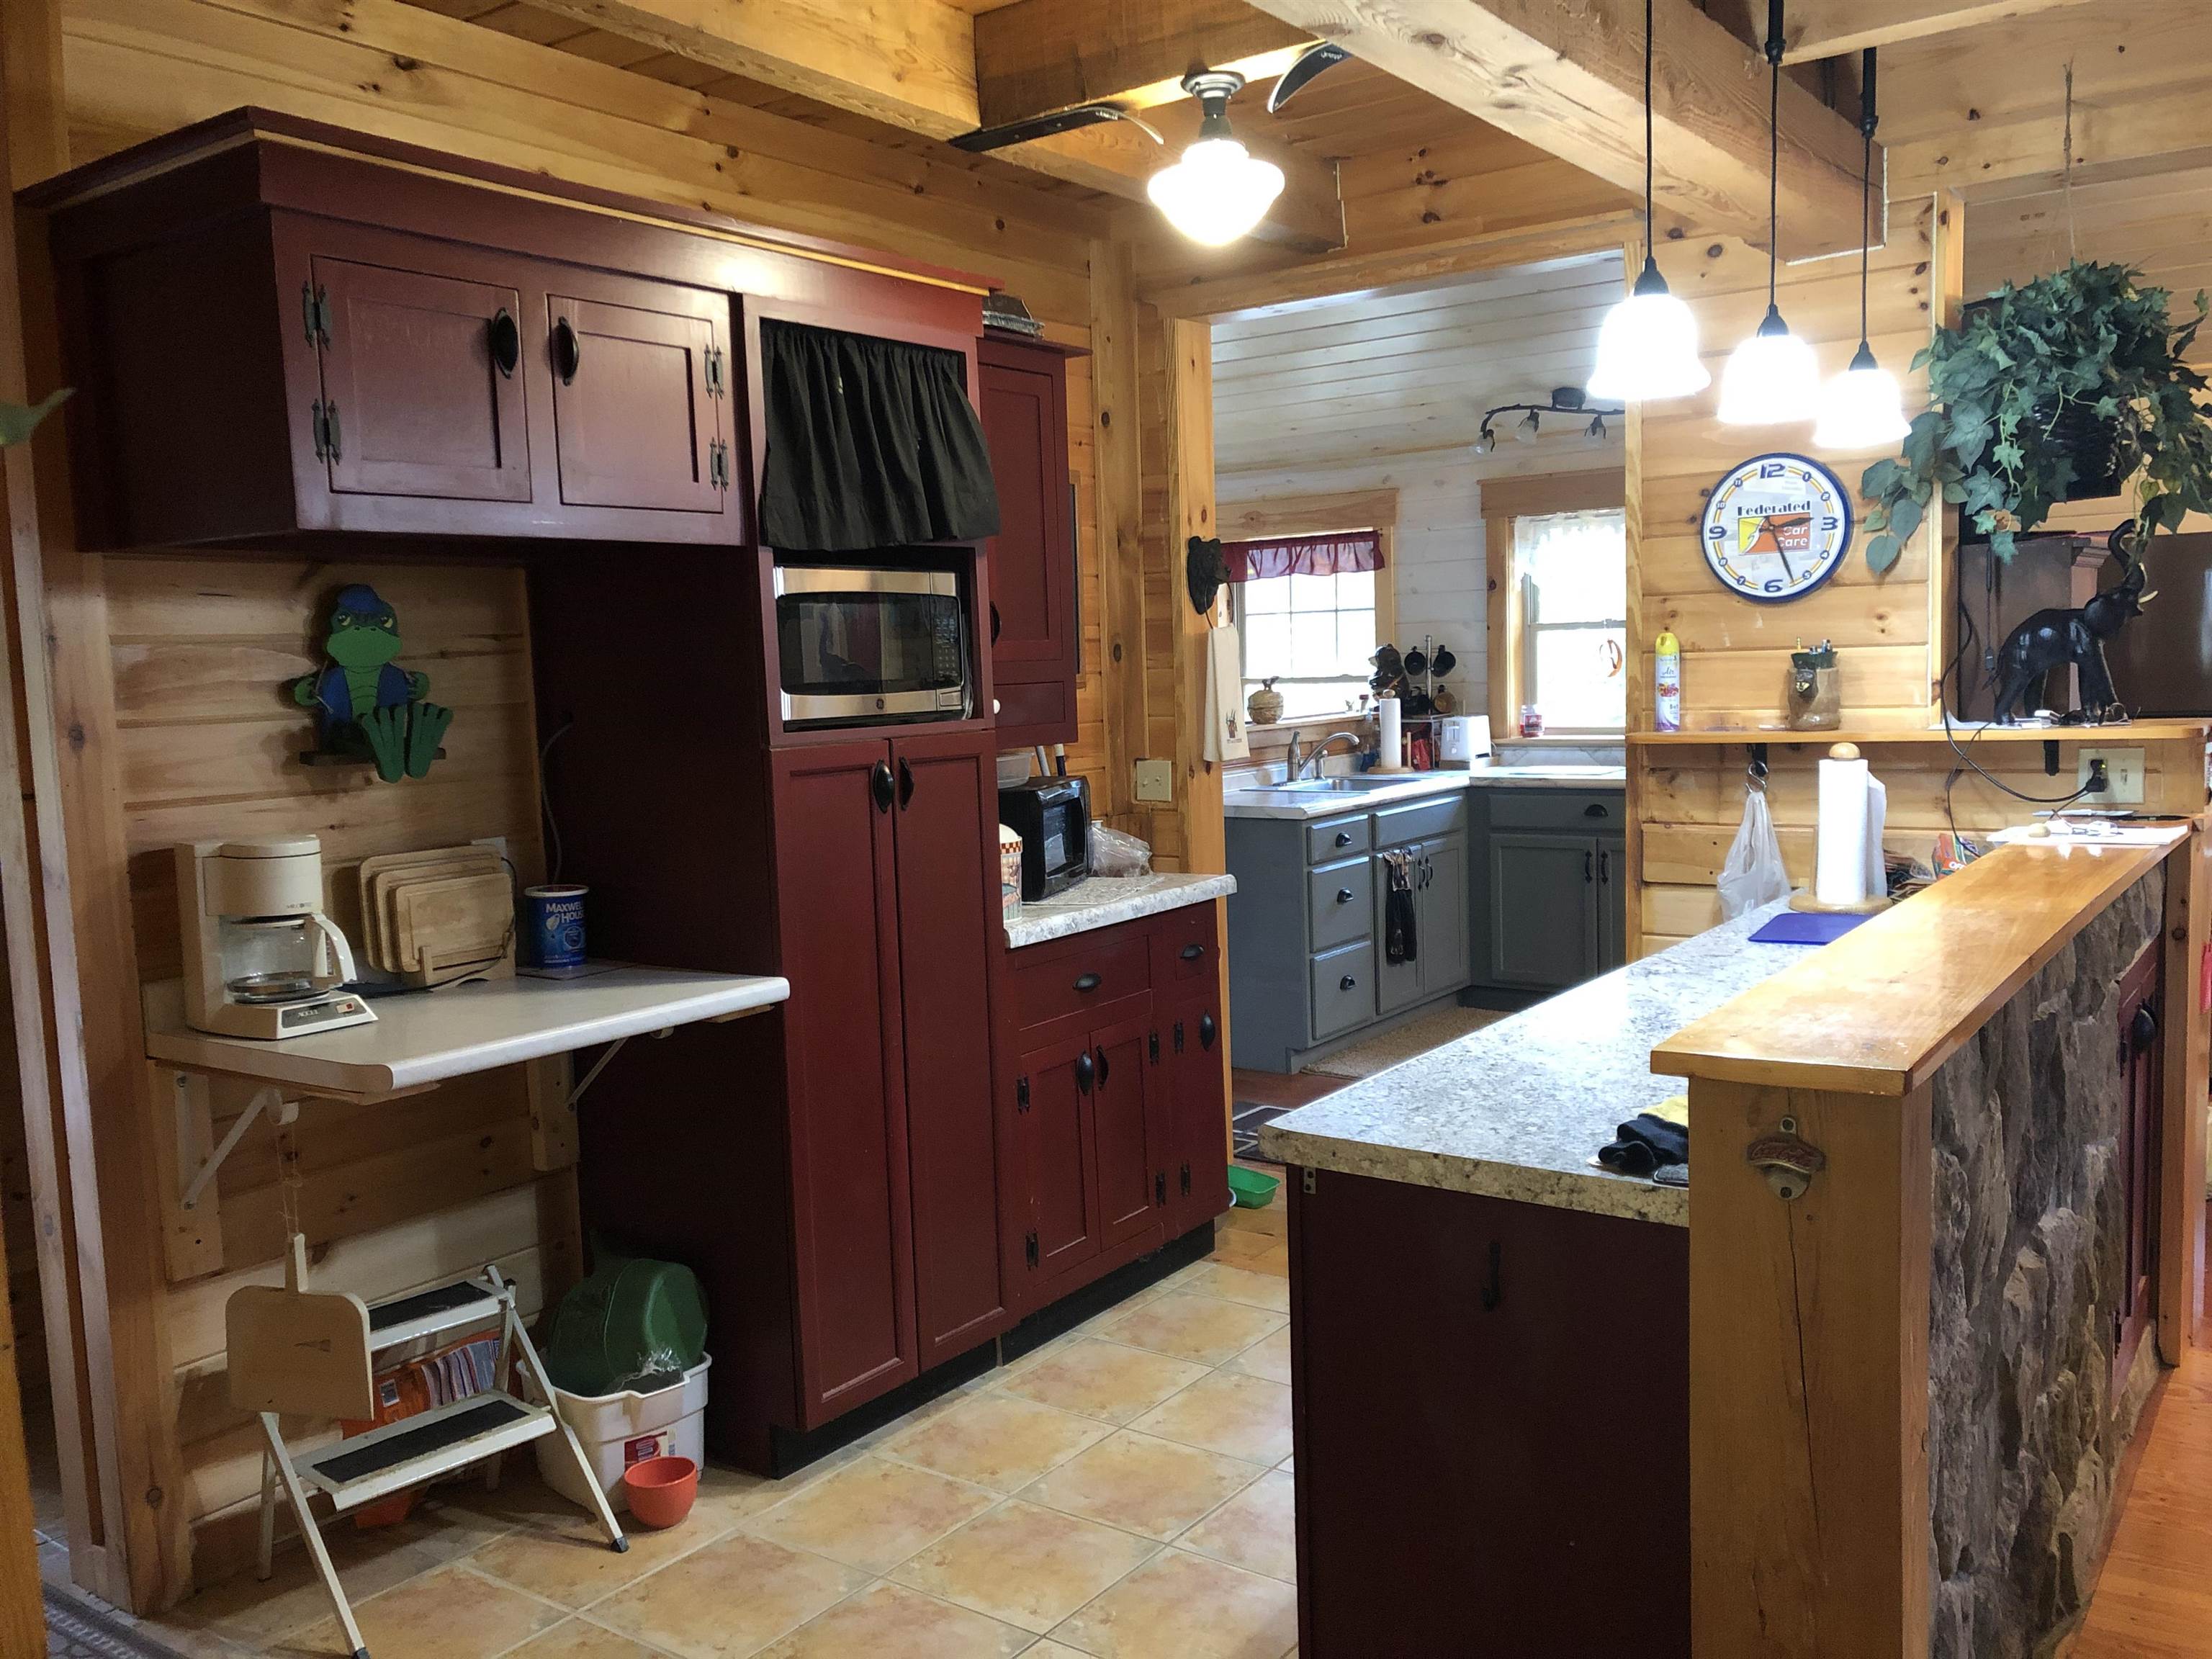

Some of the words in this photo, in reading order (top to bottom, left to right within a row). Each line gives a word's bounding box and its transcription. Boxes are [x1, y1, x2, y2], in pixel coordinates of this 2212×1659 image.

[1760, 464, 1785, 479] 12
[1737, 500, 1810, 516] Federated
[1821, 516, 1838, 531] 3
[1709, 526, 1727, 540] 9
[1783, 526, 1807, 536] Car
[1778, 536, 1807, 547] Care
[1764, 579, 1783, 593] 6
